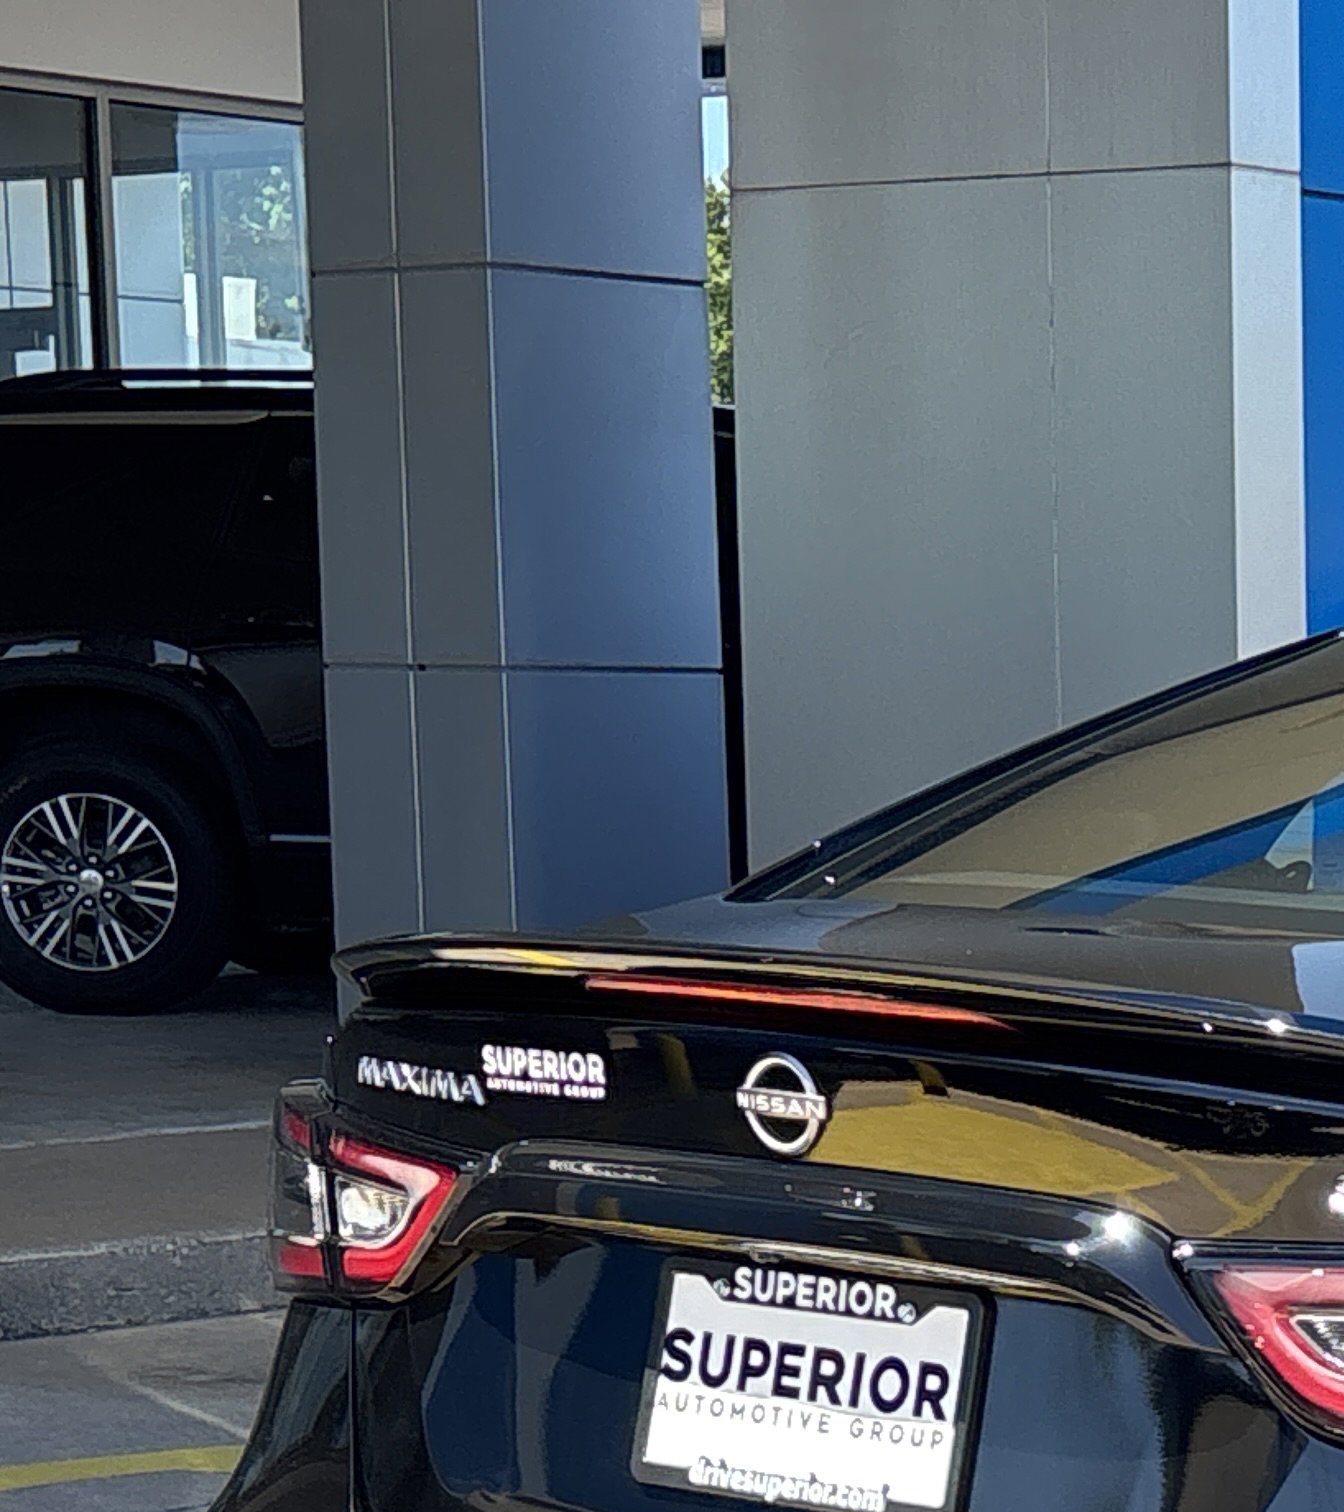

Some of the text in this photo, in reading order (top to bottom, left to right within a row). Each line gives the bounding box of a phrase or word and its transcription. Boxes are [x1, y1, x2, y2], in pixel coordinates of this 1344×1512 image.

[357, 1055, 486, 1107] MAXIMA
[482, 1044, 606, 1084] SUPERIOR
[736, 1090, 827, 1120] NISSAN
[733, 1265, 897, 1319] SUPERIOR
[660, 1326, 951, 1422] SUPERIOR
[656, 1391, 945, 1450] AUTOMOTIVE GROUP
